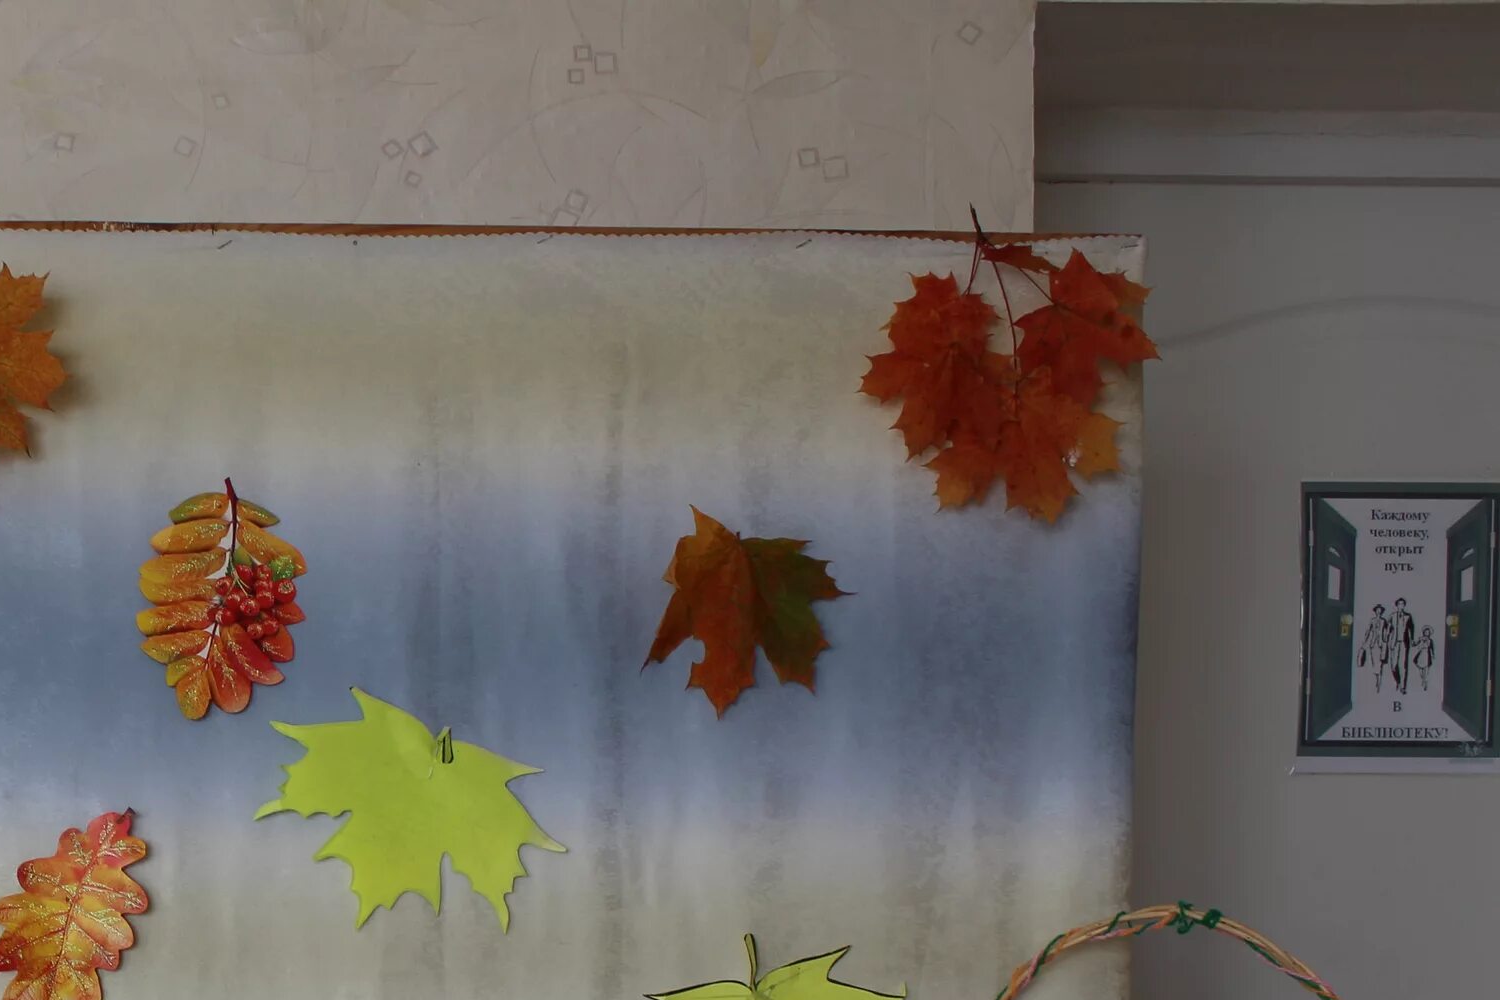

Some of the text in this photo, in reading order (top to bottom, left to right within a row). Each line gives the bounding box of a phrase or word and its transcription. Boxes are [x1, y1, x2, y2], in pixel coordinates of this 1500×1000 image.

[1370, 508, 1431, 523] Каждому
[1369, 528, 1430, 541] человеку,
[1374, 545, 1424, 557] открыт
[1384, 563, 1414, 574] путь
[1341, 726, 1449, 739] БИБЛИОТЕКУ!
